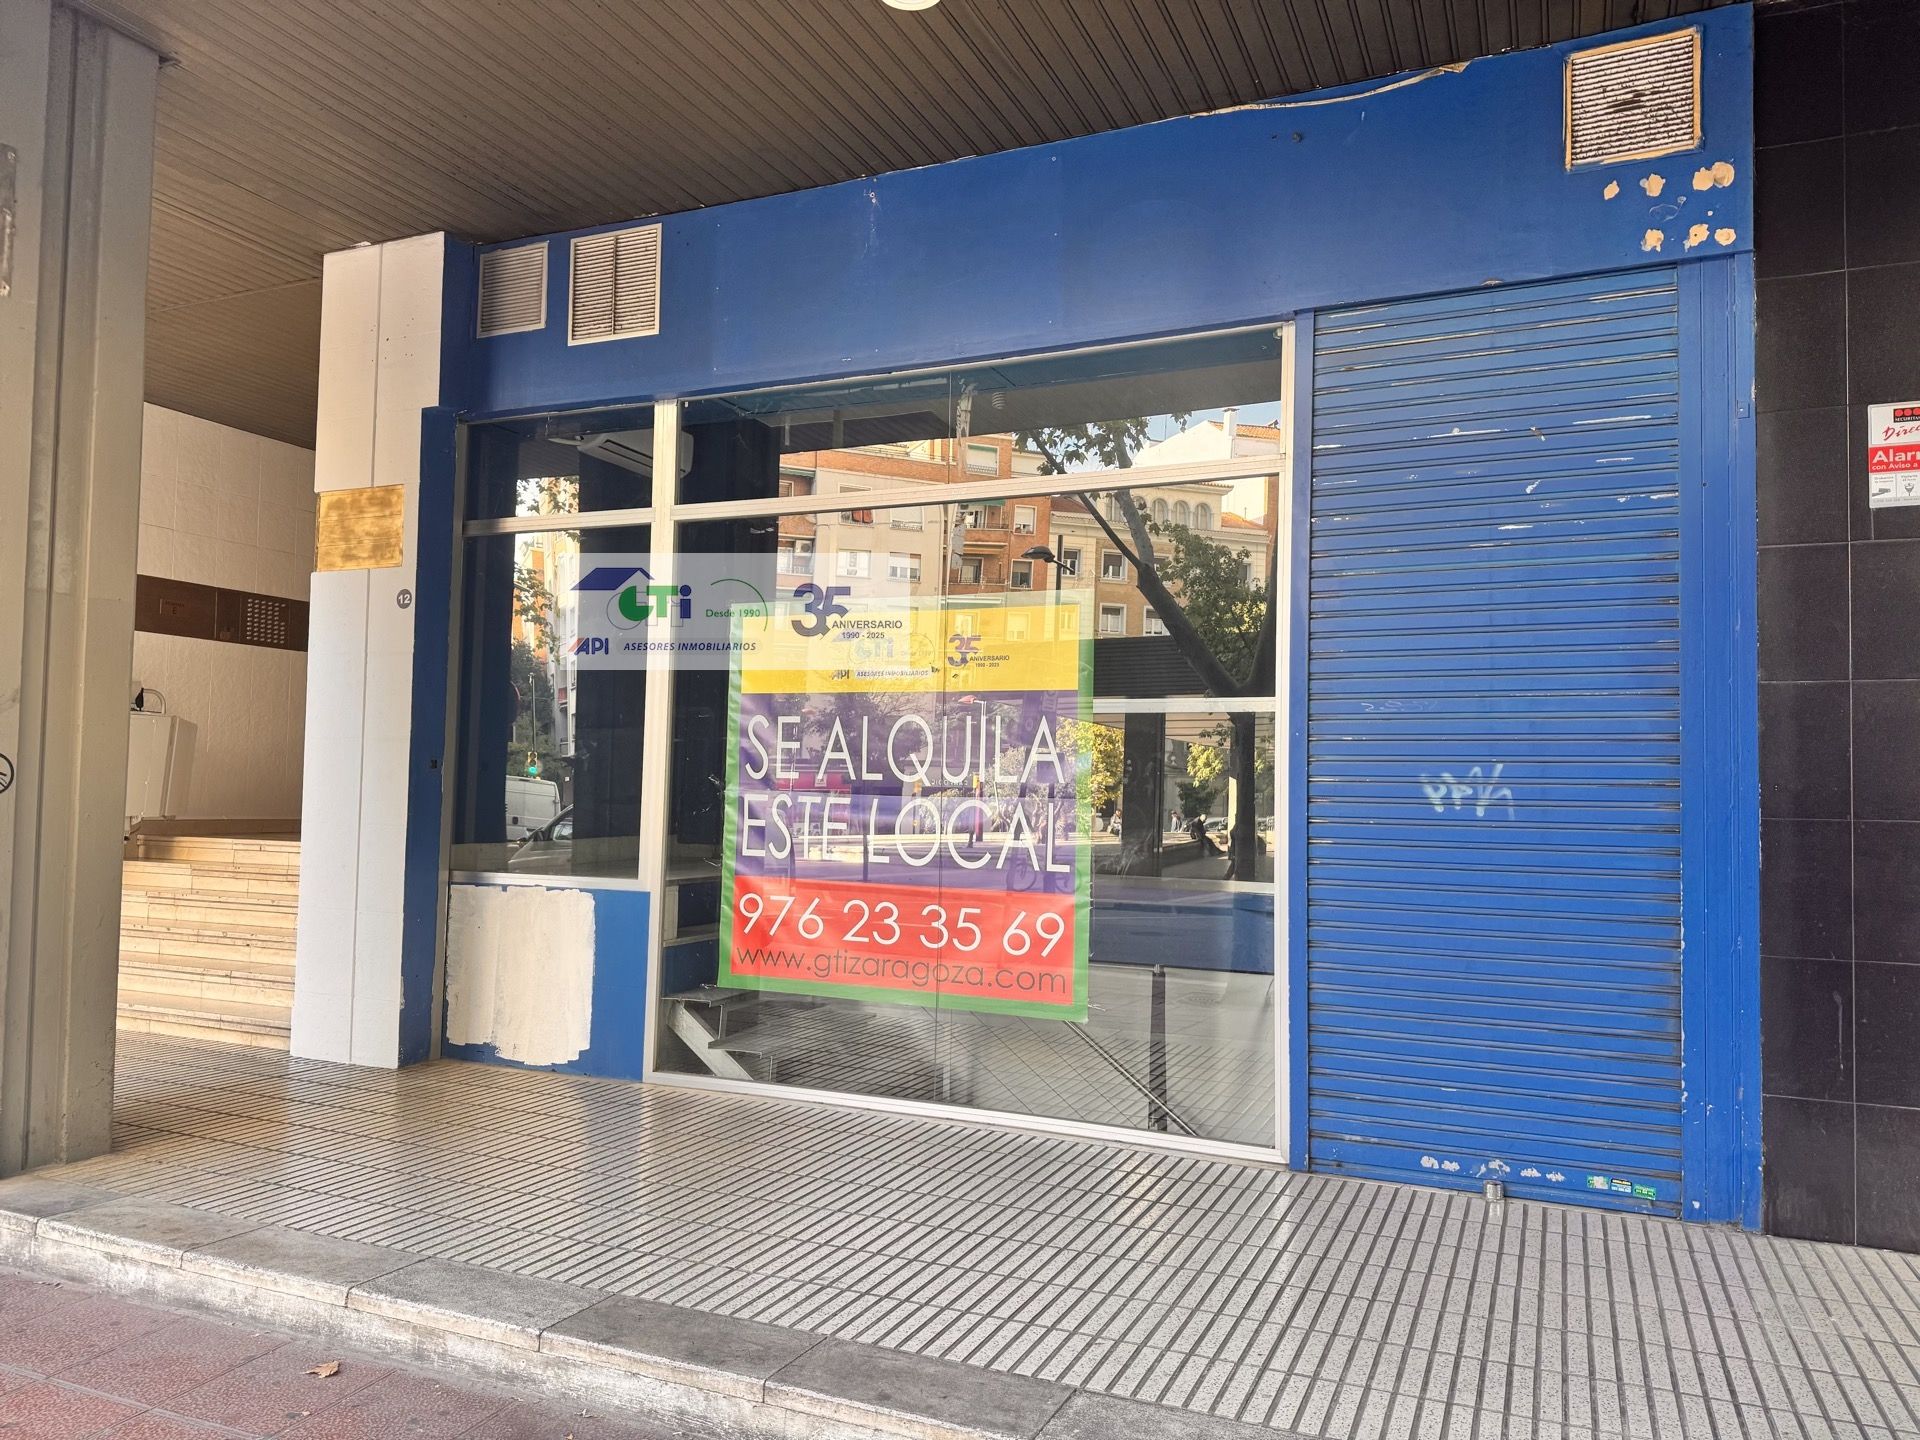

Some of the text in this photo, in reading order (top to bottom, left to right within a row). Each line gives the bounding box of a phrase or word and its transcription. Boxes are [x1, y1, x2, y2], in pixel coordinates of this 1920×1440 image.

[398, 593, 411, 605] 12
[947, 633, 982, 667] 35
[744, 714, 1066, 788] SE ALQUILA
[741, 793, 1071, 874] ESTE LOCAL
[738, 892, 1066, 958] 976 23 35 69
[736, 946, 1067, 994] www.gtizaragoza.com
